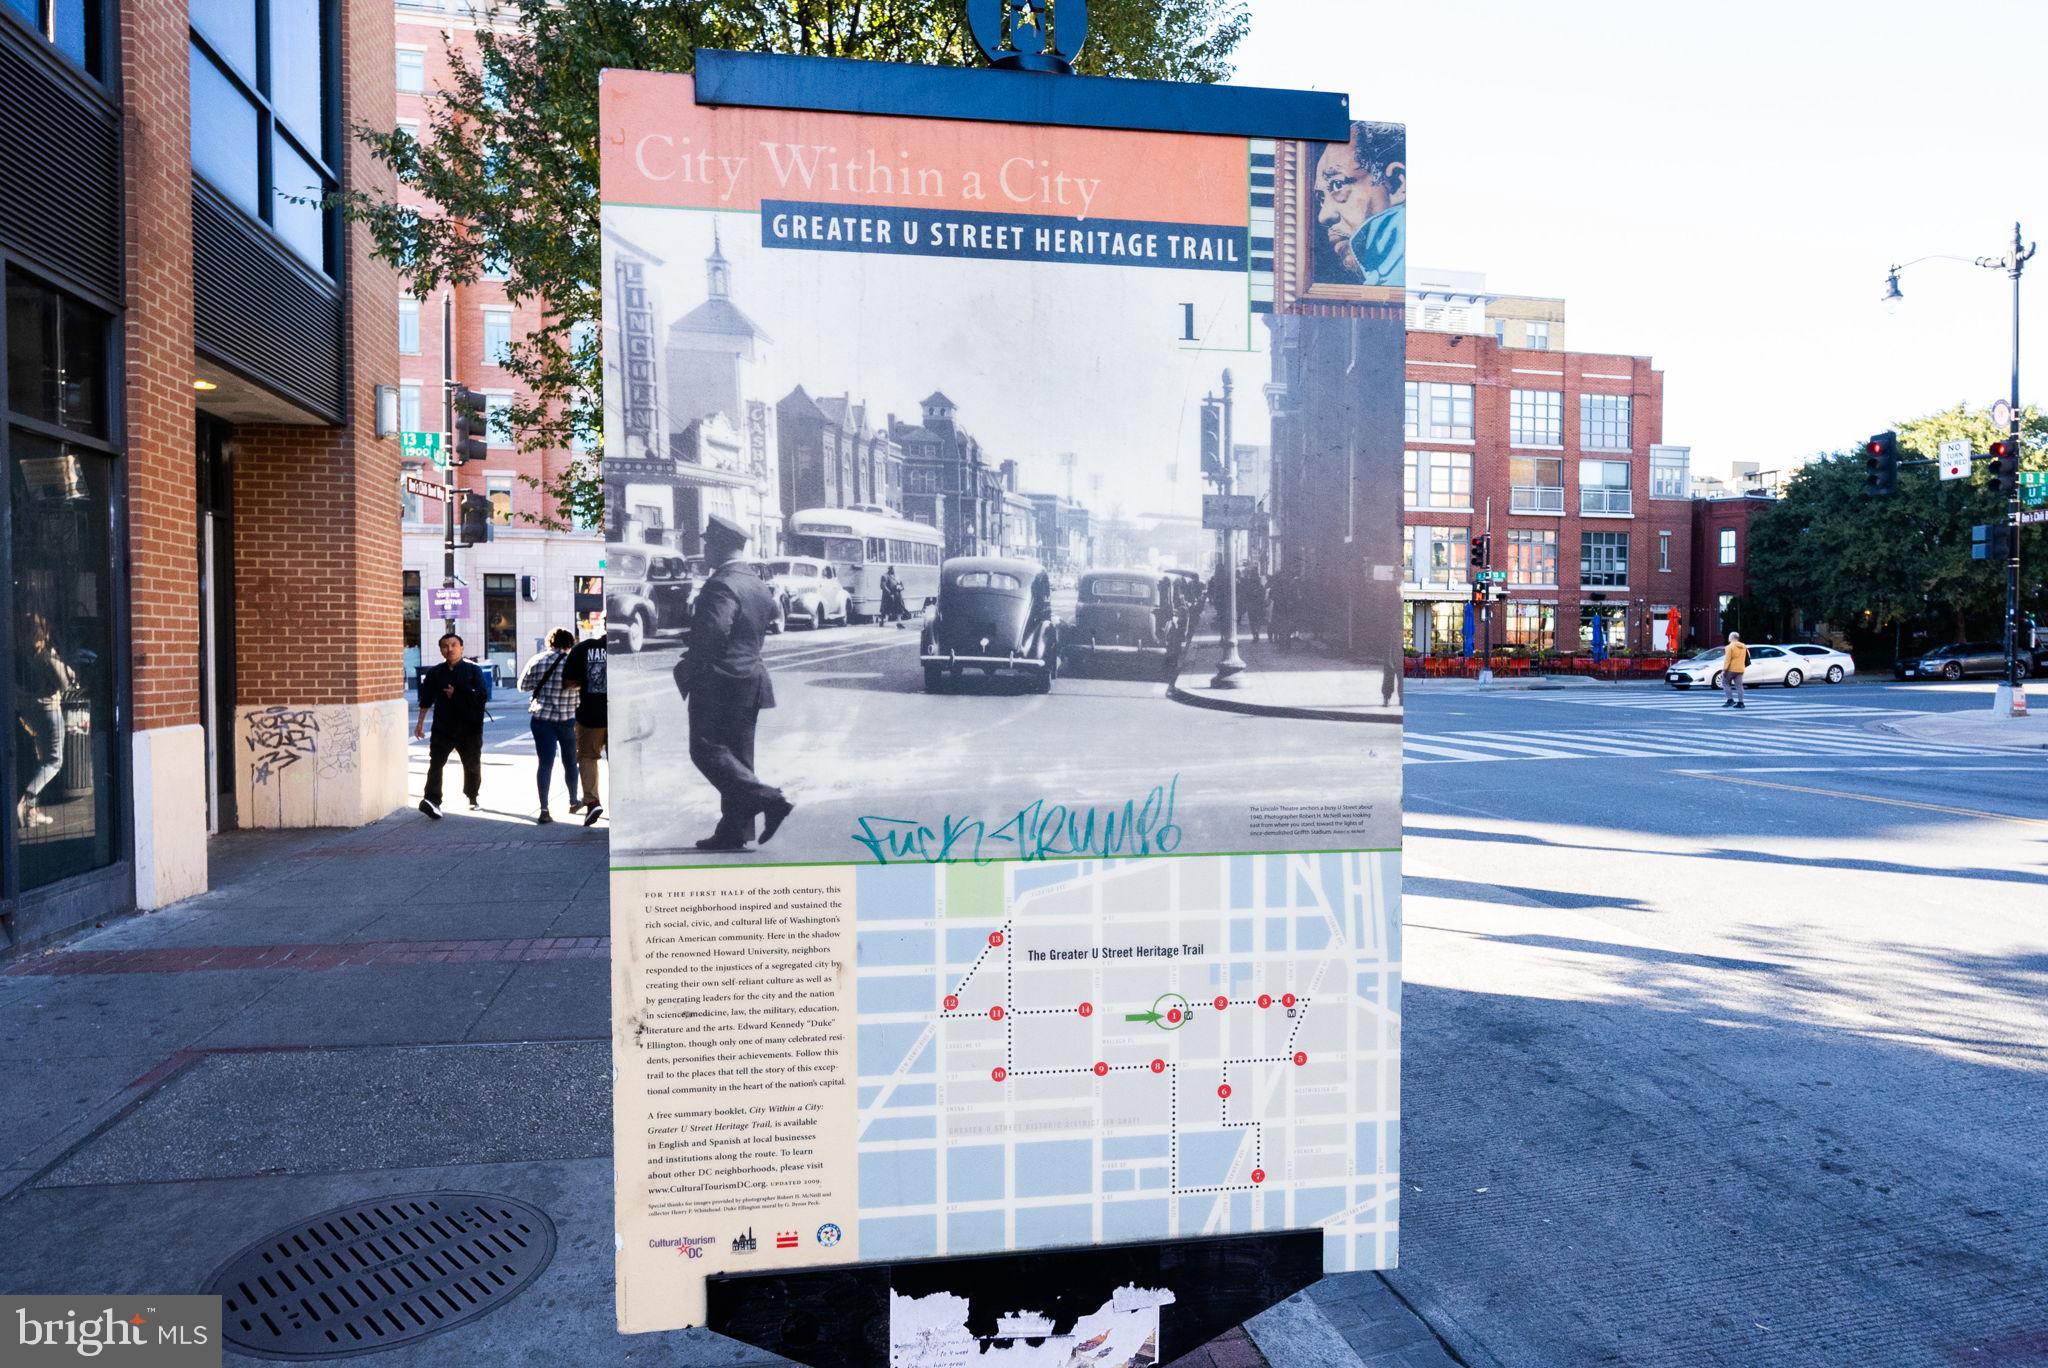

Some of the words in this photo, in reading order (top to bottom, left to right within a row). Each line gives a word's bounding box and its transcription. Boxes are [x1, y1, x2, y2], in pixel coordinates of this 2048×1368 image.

[635, 135, 745, 200] City
[760, 140, 944, 198] Within
[962, 171, 986, 200] a
[1000, 157, 1100, 220] City
[772, 214, 892, 245] GREATER
[903, 220, 919, 246] U
[930, 222, 1022, 252] STREET
[1035, 228, 1158, 258] HERITAGE
[1168, 235, 1240, 263] TRAIL
[1178, 302, 1200, 340] 1
[402, 433, 416, 446] 13
[406, 448, 430, 456] 1900
[1948, 444, 1960, 452] NO
[2029, 488, 2036, 497] U
[773, 886, 790, 894] 20th
[792, 887, 824, 896] century,
[680, 903, 737, 914] neighborhood
[739, 902, 771, 912] inspired
[773, 901, 788, 909] and
[790, 900, 827, 909] sustained
[645, 920, 661, 928] rich
[663, 919, 689, 928] social,
[690, 919, 712, 927] civic,
[714, 918, 729, 926] and
[731, 917, 762, 926] cultural
[764, 916, 777, 925] life
[778, 916, 788, 924] of
[645, 935, 675, 943] African
[677, 934, 716, 942] American
[718, 932, 764, 942] community.
[767, 932, 785, 940] Here
[797, 930, 809, 938] the
[811, 930, 840, 938] shadow
[645, 950, 654, 958] of
[655, 950, 668, 958] the
[671, 949, 711, 957] renowned
[713, 948, 745, 956] Howard
[747, 946, 789, 957] University,
[791, 945, 830, 956] neighbors
[1028, 950, 1046, 961] The
[1049, 949, 1088, 960] Greater
[1092, 948, 1098, 959] U
[1102, 947, 1133, 959] Street
[1136, 945, 1179, 959] Heritage
[1182, 944, 1204, 955] Trail
[645, 964, 687, 976] responded
[715, 963, 753, 973] injustices
[771, 960, 812, 971] segregated
[814, 960, 829, 969] city
[830, 959, 842, 972] by
[656, 1110, 672, 1119] free
[673, 1110, 712, 1119] summary
[714, 1106, 747, 1116] booklet,
[749, 1106, 766, 1116] City
[768, 1104, 795, 1112] Within
[804, 1103, 823, 1112] City:
[647, 1125, 678, 1134] Greater
[689, 1123, 712, 1132] Street
[715, 1121, 748, 1132] Heritage
[751, 1120, 772, 1129] Trail,
[783, 1117, 817, 1126] available
[658, 1139, 689, 1151] English
[691, 1138, 706, 1147] and
[709, 1136, 740, 1147] Spanish
[753, 1134, 772, 1143] local
[774, 1132, 816, 1142] businesses
[647, 1156, 663, 1164] and
[665, 1153, 712, 1163] institutions
[714, 1151, 737, 1162] along
[792, 1147, 813, 1155] learn
[647, 1170, 671, 1179] about
[673, 1169, 695, 1178] other
[698, 1168, 712, 1176] DC
[714, 1164, 777, 1177] neighborhoods,
[780, 1162, 804, 1173] please
[649, 1238, 681, 1248] Cultural
[683, 1236, 716, 1246] Tourism
[688, 1248, 703, 1258] DC
